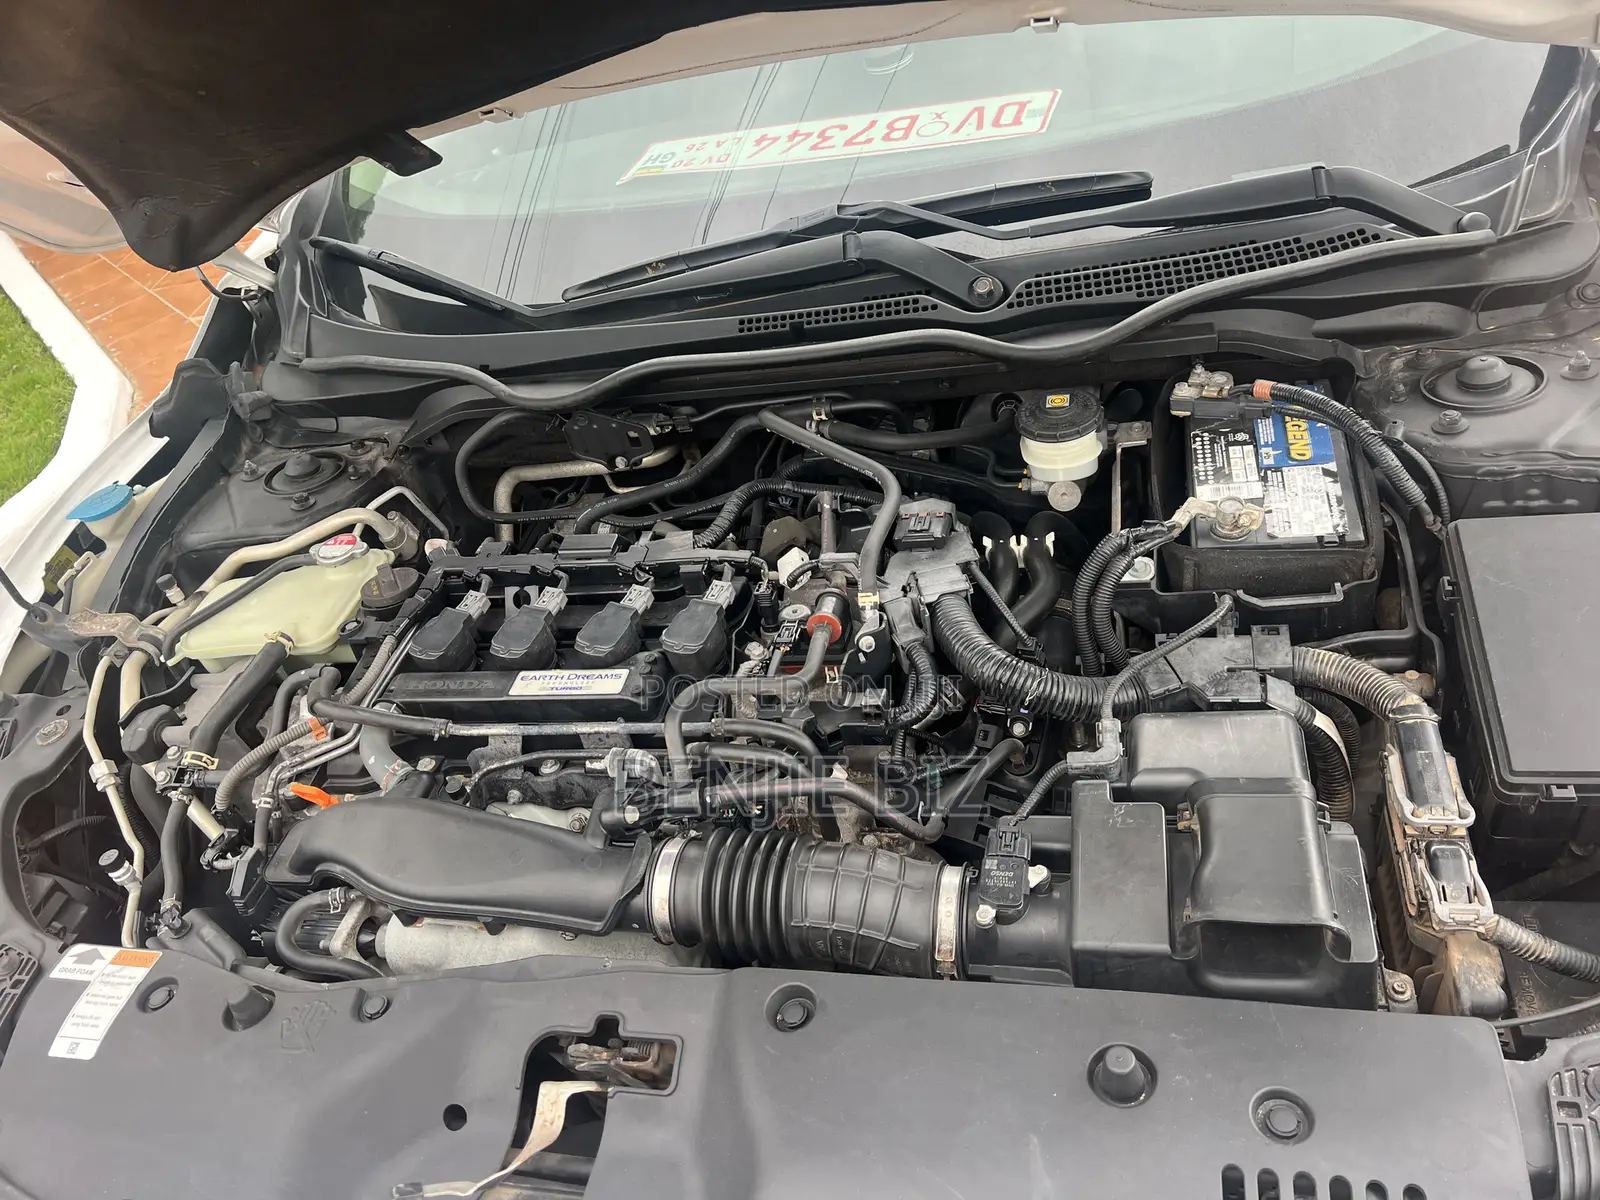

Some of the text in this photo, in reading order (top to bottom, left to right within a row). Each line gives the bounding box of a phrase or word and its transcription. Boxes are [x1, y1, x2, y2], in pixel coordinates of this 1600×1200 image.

[951, 100, 1032, 134] DV
[747, 114, 920, 158] B7344
[641, 152, 676, 166] GH
[671, 153, 731, 168] DV 20
[1285, 405, 1312, 460] EGEND
[567, 673, 623, 681] DREAMS
[405, 680, 496, 690] HONDA
